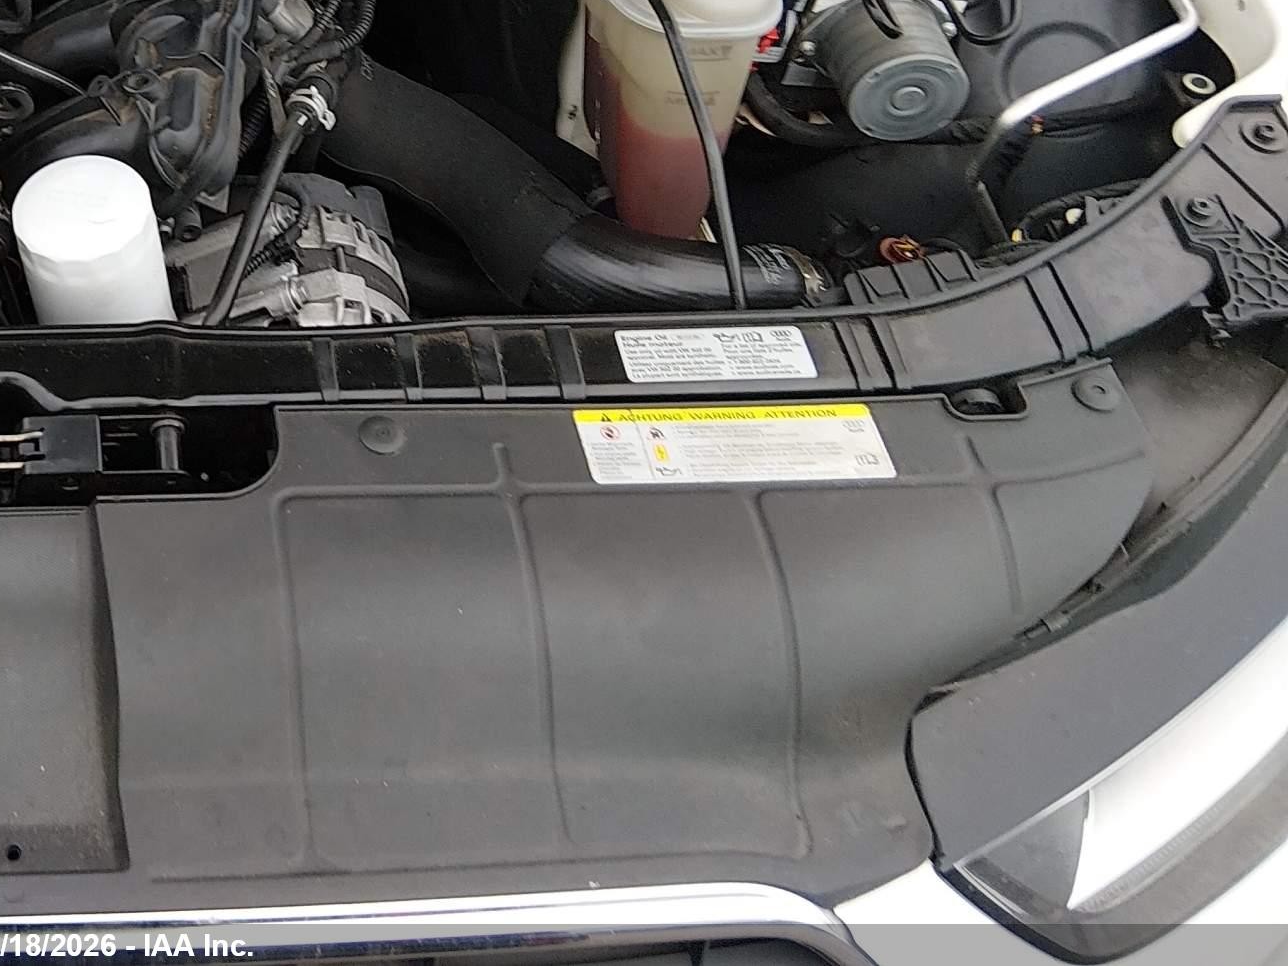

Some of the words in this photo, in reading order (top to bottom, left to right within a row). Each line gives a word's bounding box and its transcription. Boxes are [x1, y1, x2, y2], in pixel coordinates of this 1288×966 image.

[618, 413, 684, 422] ACHTUNG
[688, 410, 756, 420] WARNING
[764, 408, 838, 418] ATTENTION
